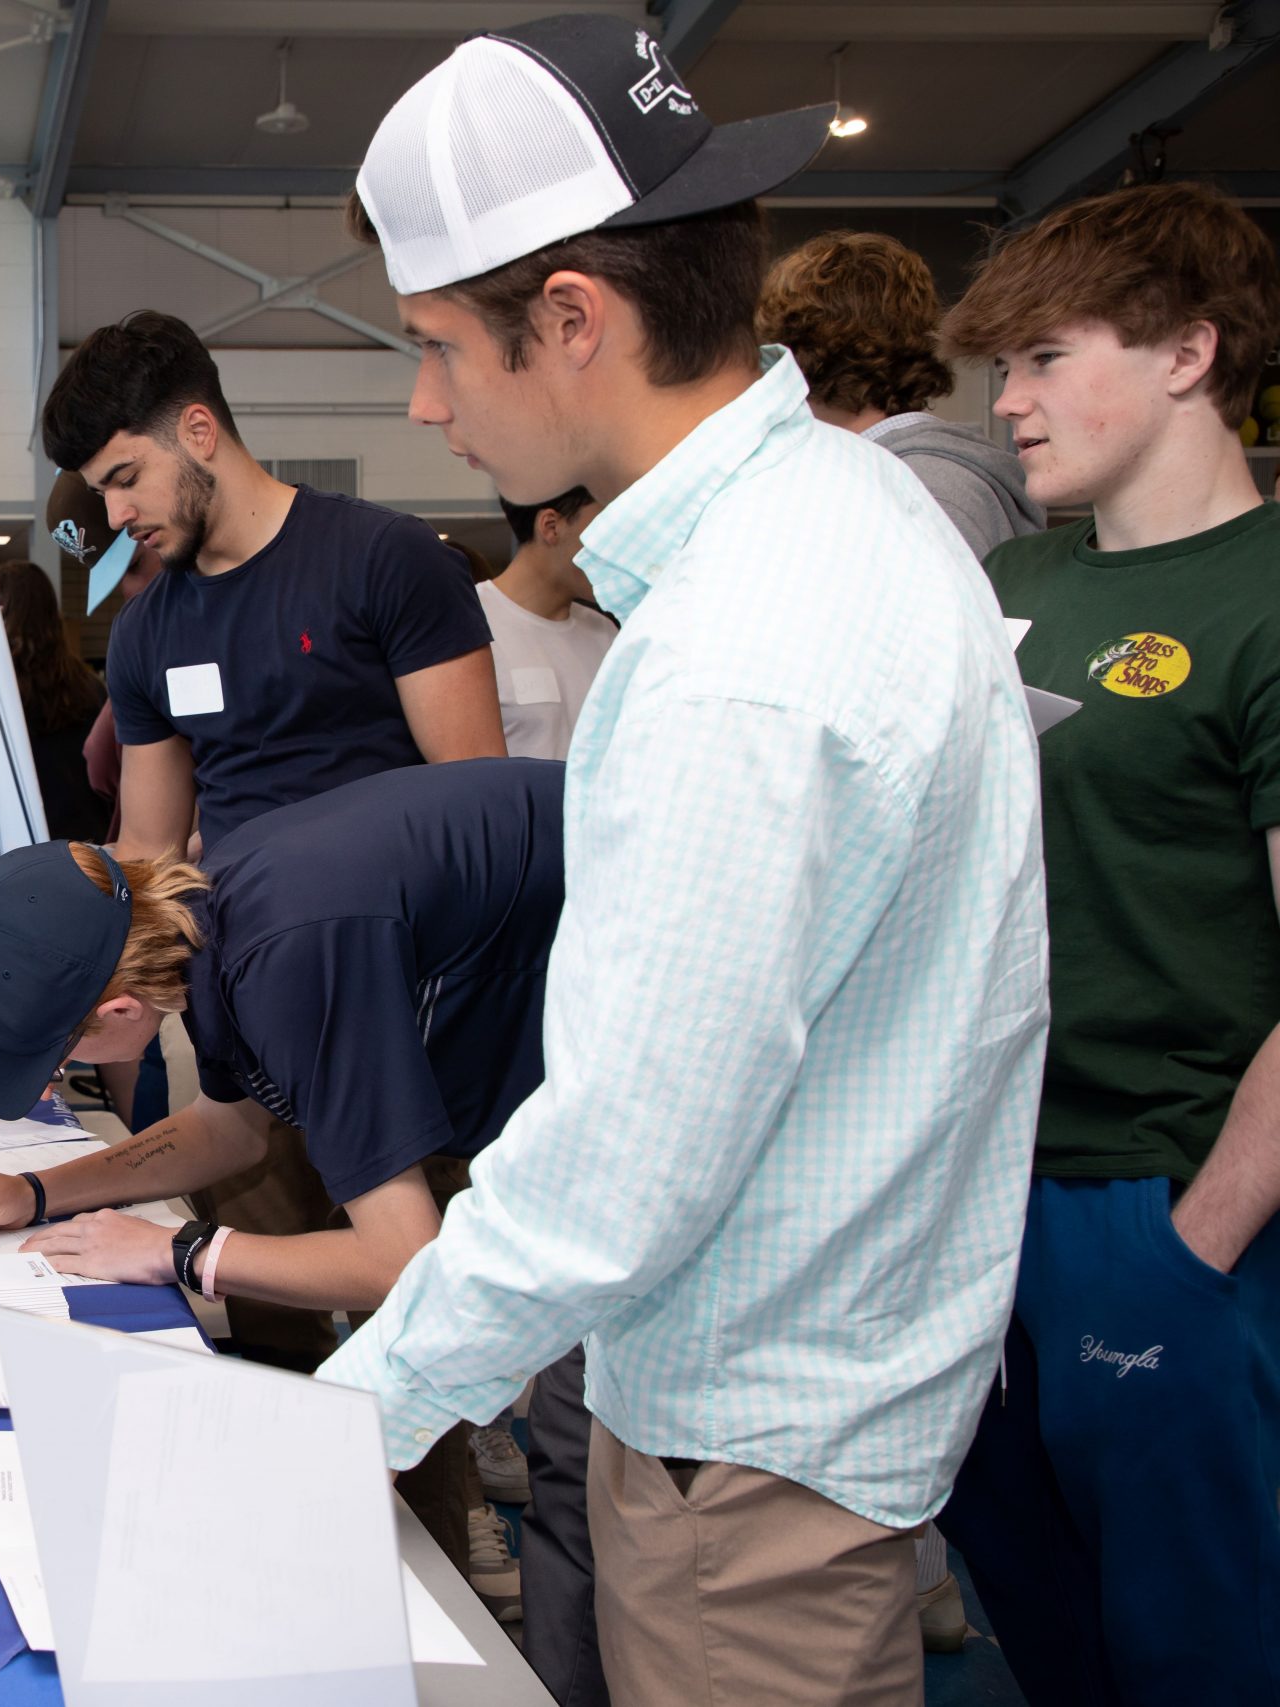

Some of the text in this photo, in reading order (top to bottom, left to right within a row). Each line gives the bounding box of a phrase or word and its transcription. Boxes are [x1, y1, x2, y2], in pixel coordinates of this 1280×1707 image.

[1136, 634, 1178, 658] Bass
[1125, 650, 1158, 671] Pro
[1115, 666, 1169, 695] Shops
